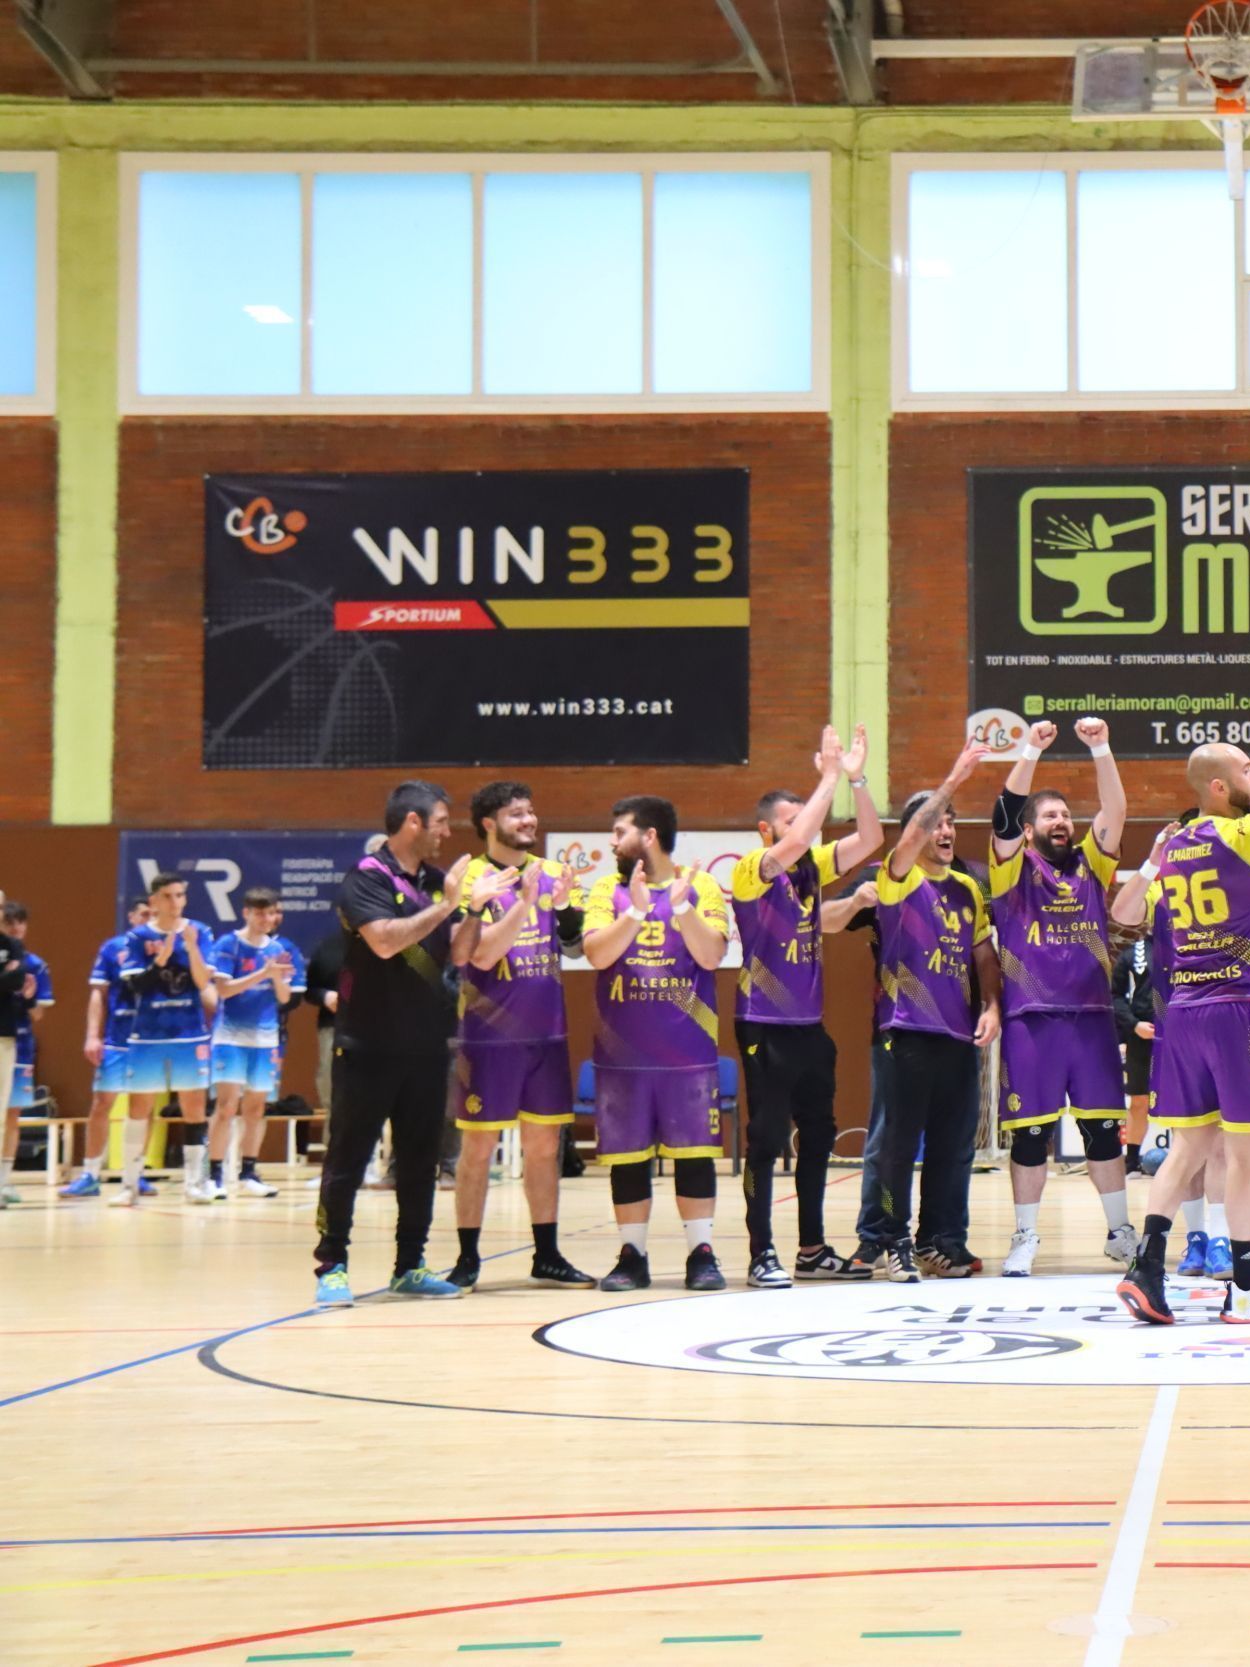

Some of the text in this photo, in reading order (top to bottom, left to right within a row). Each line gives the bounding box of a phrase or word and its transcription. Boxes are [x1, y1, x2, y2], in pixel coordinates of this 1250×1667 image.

[358, 606, 461, 628] SPORTIUM
[986, 655, 1004, 666] TOT
[1005, 655, 1018, 666] EN
[1019, 655, 1050, 666] FERRO
[1057, 654, 1112, 665] INOXIDABLE
[1120, 654, 1185, 665] ESTRUCTURES
[478, 698, 674, 717] www.win333.cat
[1152, 721, 1170, 744] T.
[1176, 721, 1220, 744] 665
[1163, 868, 1230, 930] 36
[635, 920, 666, 947] 23
[629, 977, 694, 989] ALEGRIA
[629, 991, 683, 1001] HOTELS
